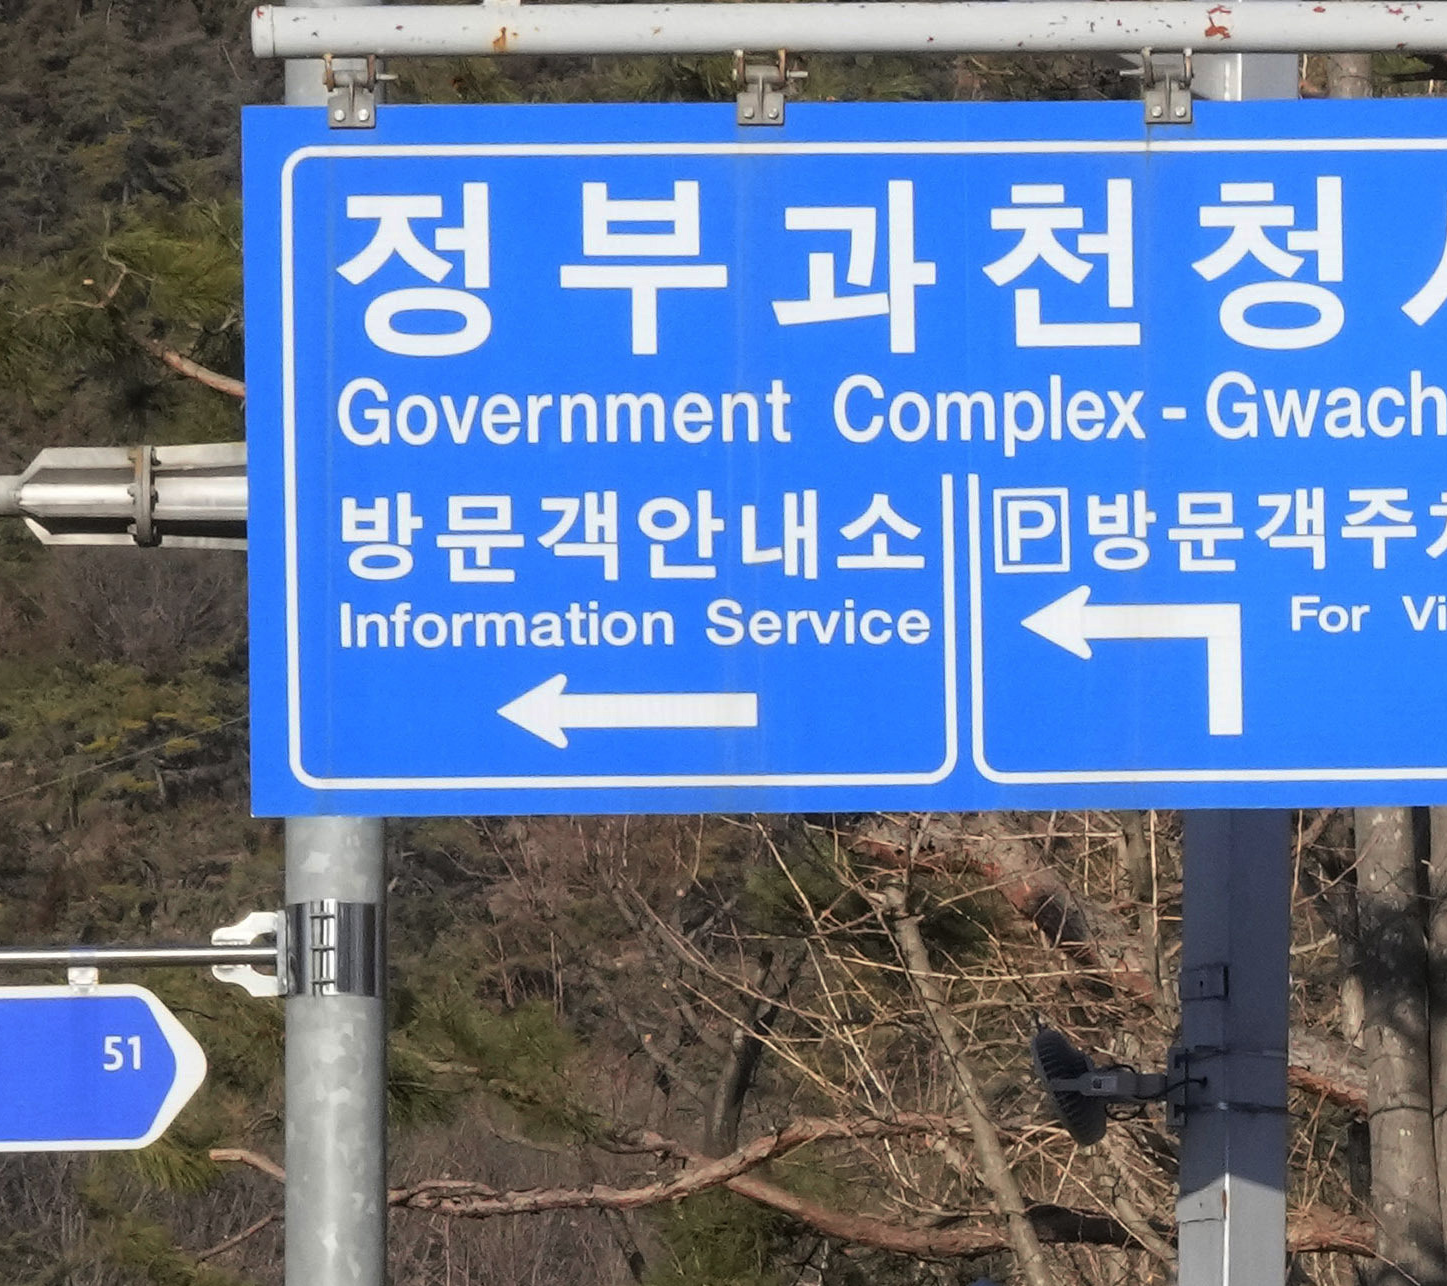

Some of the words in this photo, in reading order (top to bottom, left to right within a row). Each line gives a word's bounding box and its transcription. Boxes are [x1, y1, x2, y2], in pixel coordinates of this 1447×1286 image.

[337, 377, 793, 447] Government
[341, 489, 927, 584] 방문객안내소
[340, 601, 676, 650] Information
[706, 598, 932, 648] Service
[1291, 595, 1371, 635] For
[103, 1035, 143, 1072] 51
